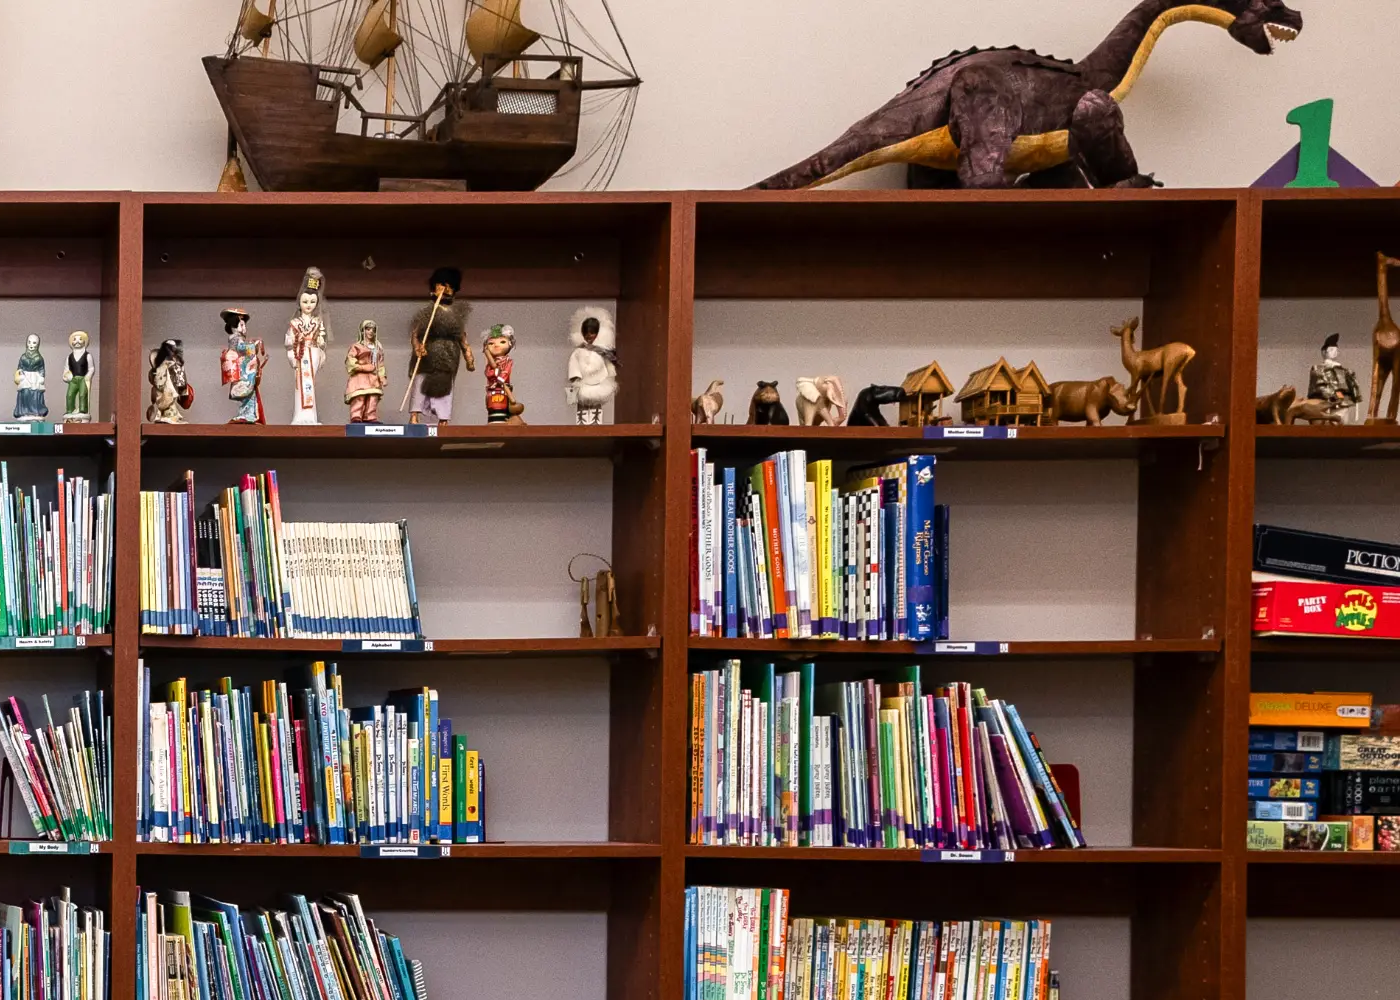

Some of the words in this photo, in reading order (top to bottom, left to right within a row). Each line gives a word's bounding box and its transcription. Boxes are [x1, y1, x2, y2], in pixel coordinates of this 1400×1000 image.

[1286, 98, 1339, 188] 1
[727, 517, 735, 548] MOTHER
[772, 528, 780, 555] MOTHER
[923, 520, 931, 548] Mother
[912, 532, 923, 565] Rhymes
[1297, 596, 1327, 607] PARTY
[1304, 604, 1322, 614] BOX
[1295, 702, 1332, 711] DELUXE
[442, 764, 450, 780] First
[442, 781, 450, 811] Words
